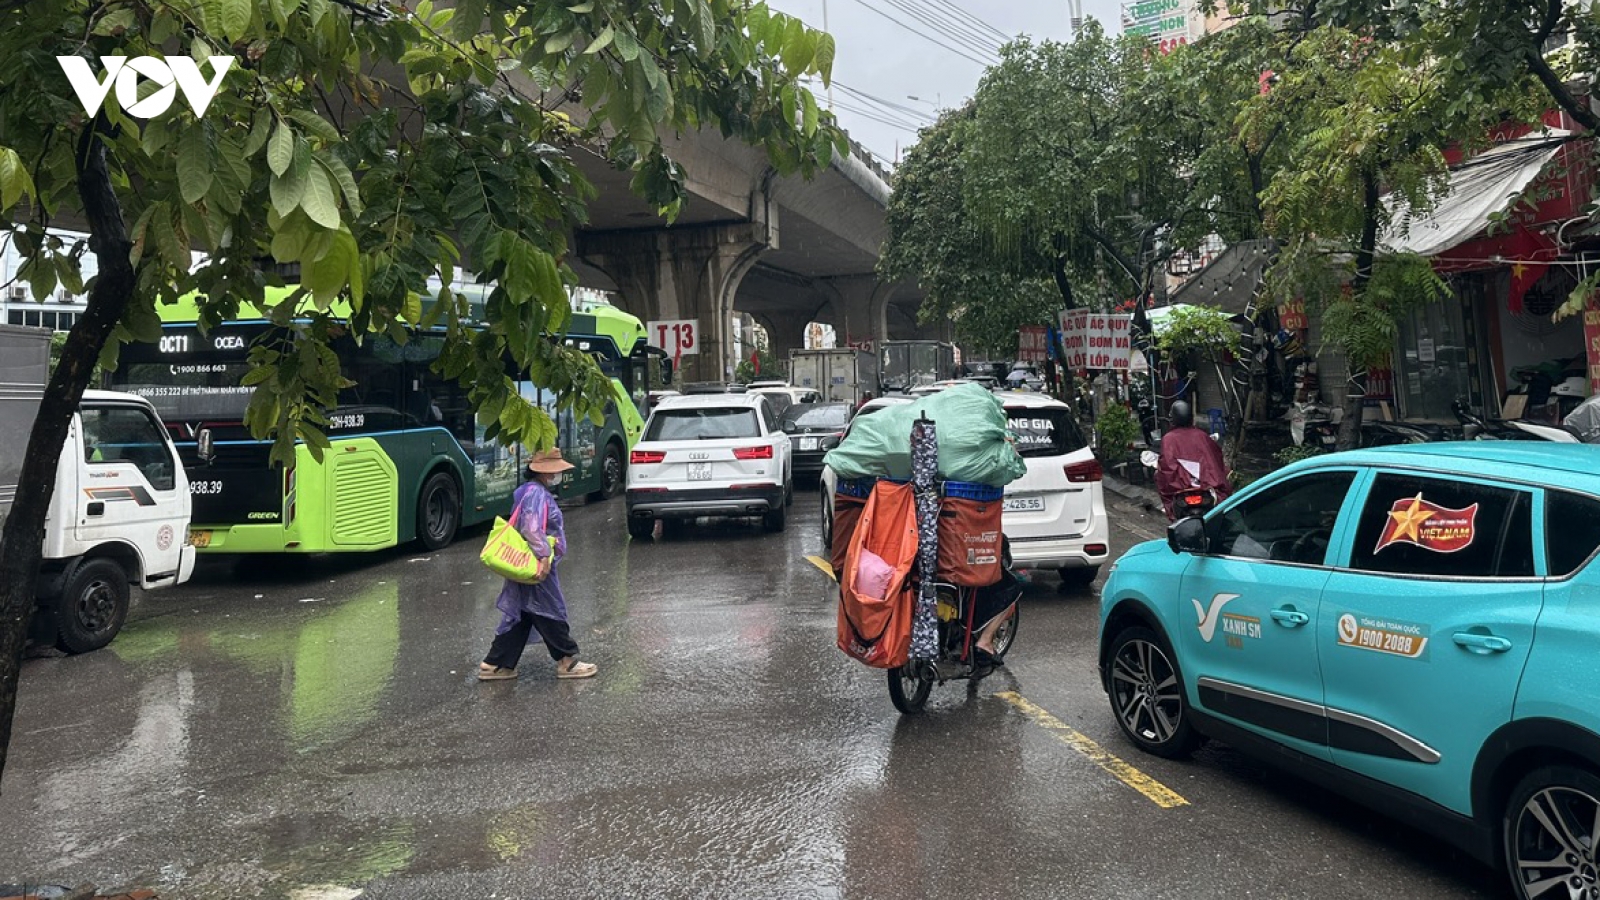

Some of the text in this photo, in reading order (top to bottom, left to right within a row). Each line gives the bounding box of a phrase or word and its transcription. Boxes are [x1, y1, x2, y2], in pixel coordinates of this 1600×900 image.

[1160, 16, 1185, 31] NON
[1075, 317, 1087, 330] QU
[1108, 318, 1129, 332] QUY
[657, 323, 694, 349] T 13
[168, 386, 181, 395] 222
[1005, 418, 1054, 430] NG GIA
[1444, 527, 1470, 539] NAM
[1222, 618, 1262, 639] XANH SM
[1359, 628, 1413, 654] 1900 2088
